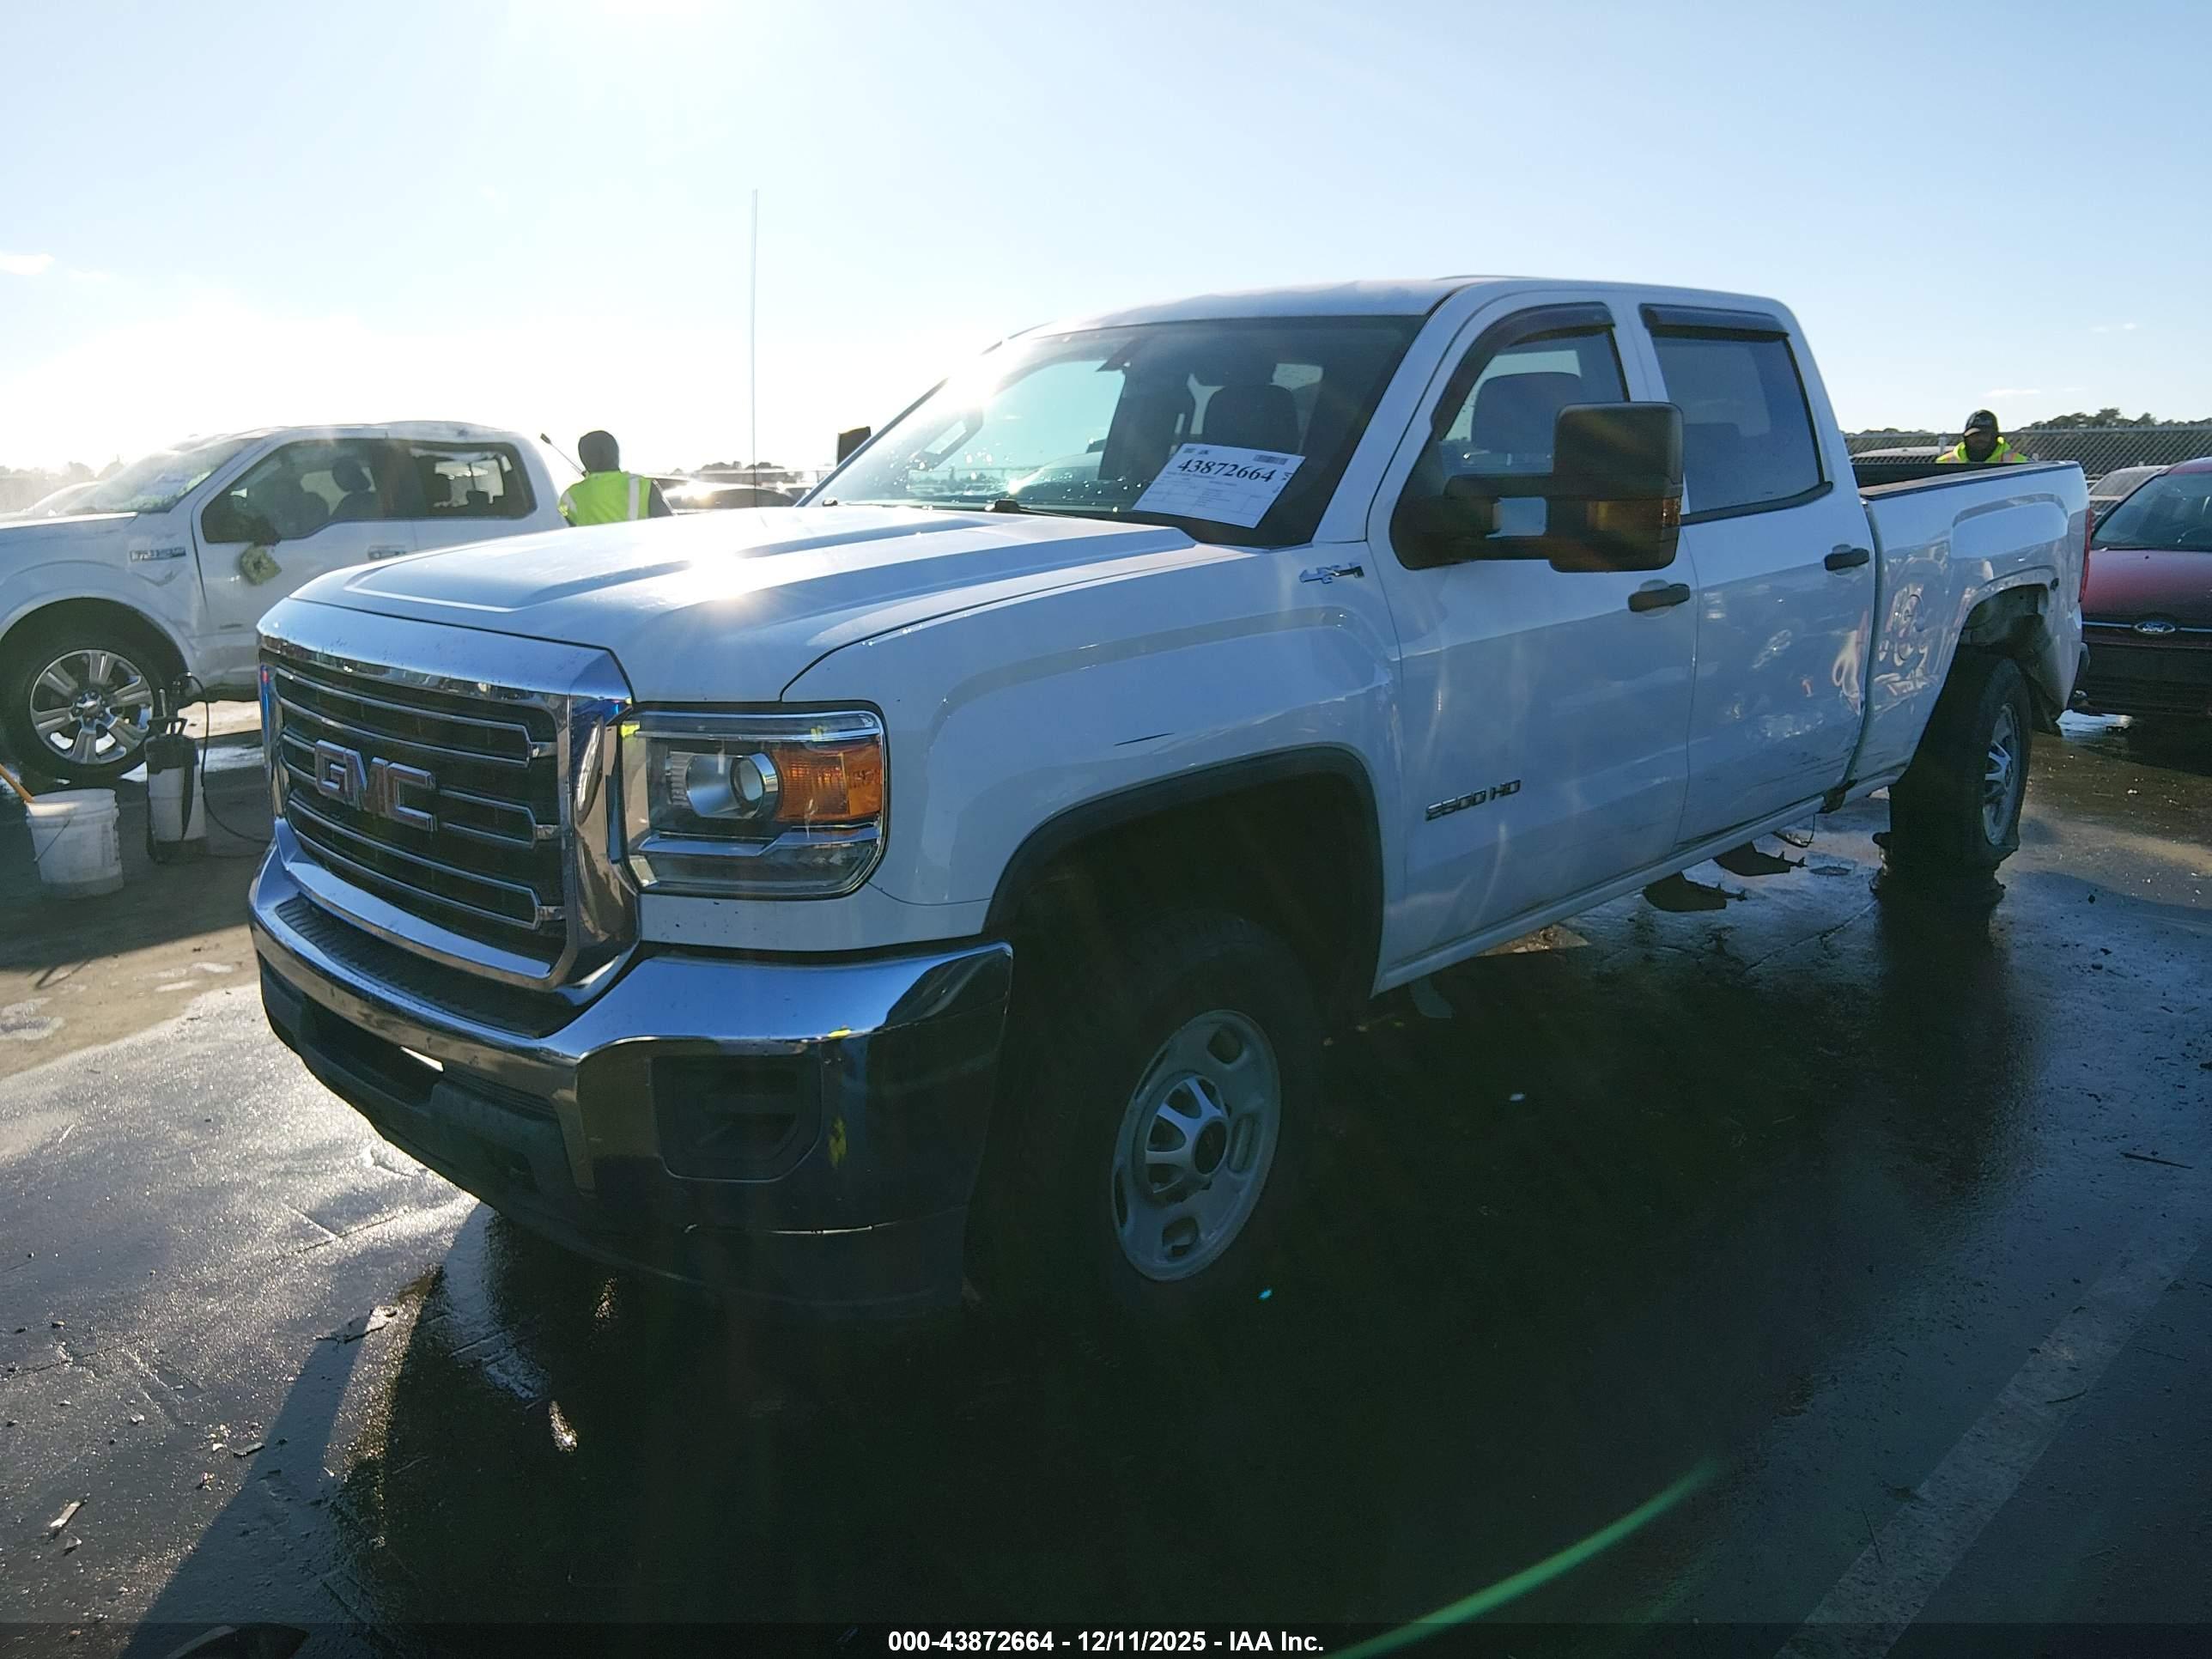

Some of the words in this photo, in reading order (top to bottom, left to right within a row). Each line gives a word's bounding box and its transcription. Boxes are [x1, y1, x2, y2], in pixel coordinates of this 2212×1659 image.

[1177, 459, 1277, 482] 43872664
[315, 738, 436, 831] GMC
[1425, 789, 1486, 822] 2500
[1490, 779, 1522, 800] HD
